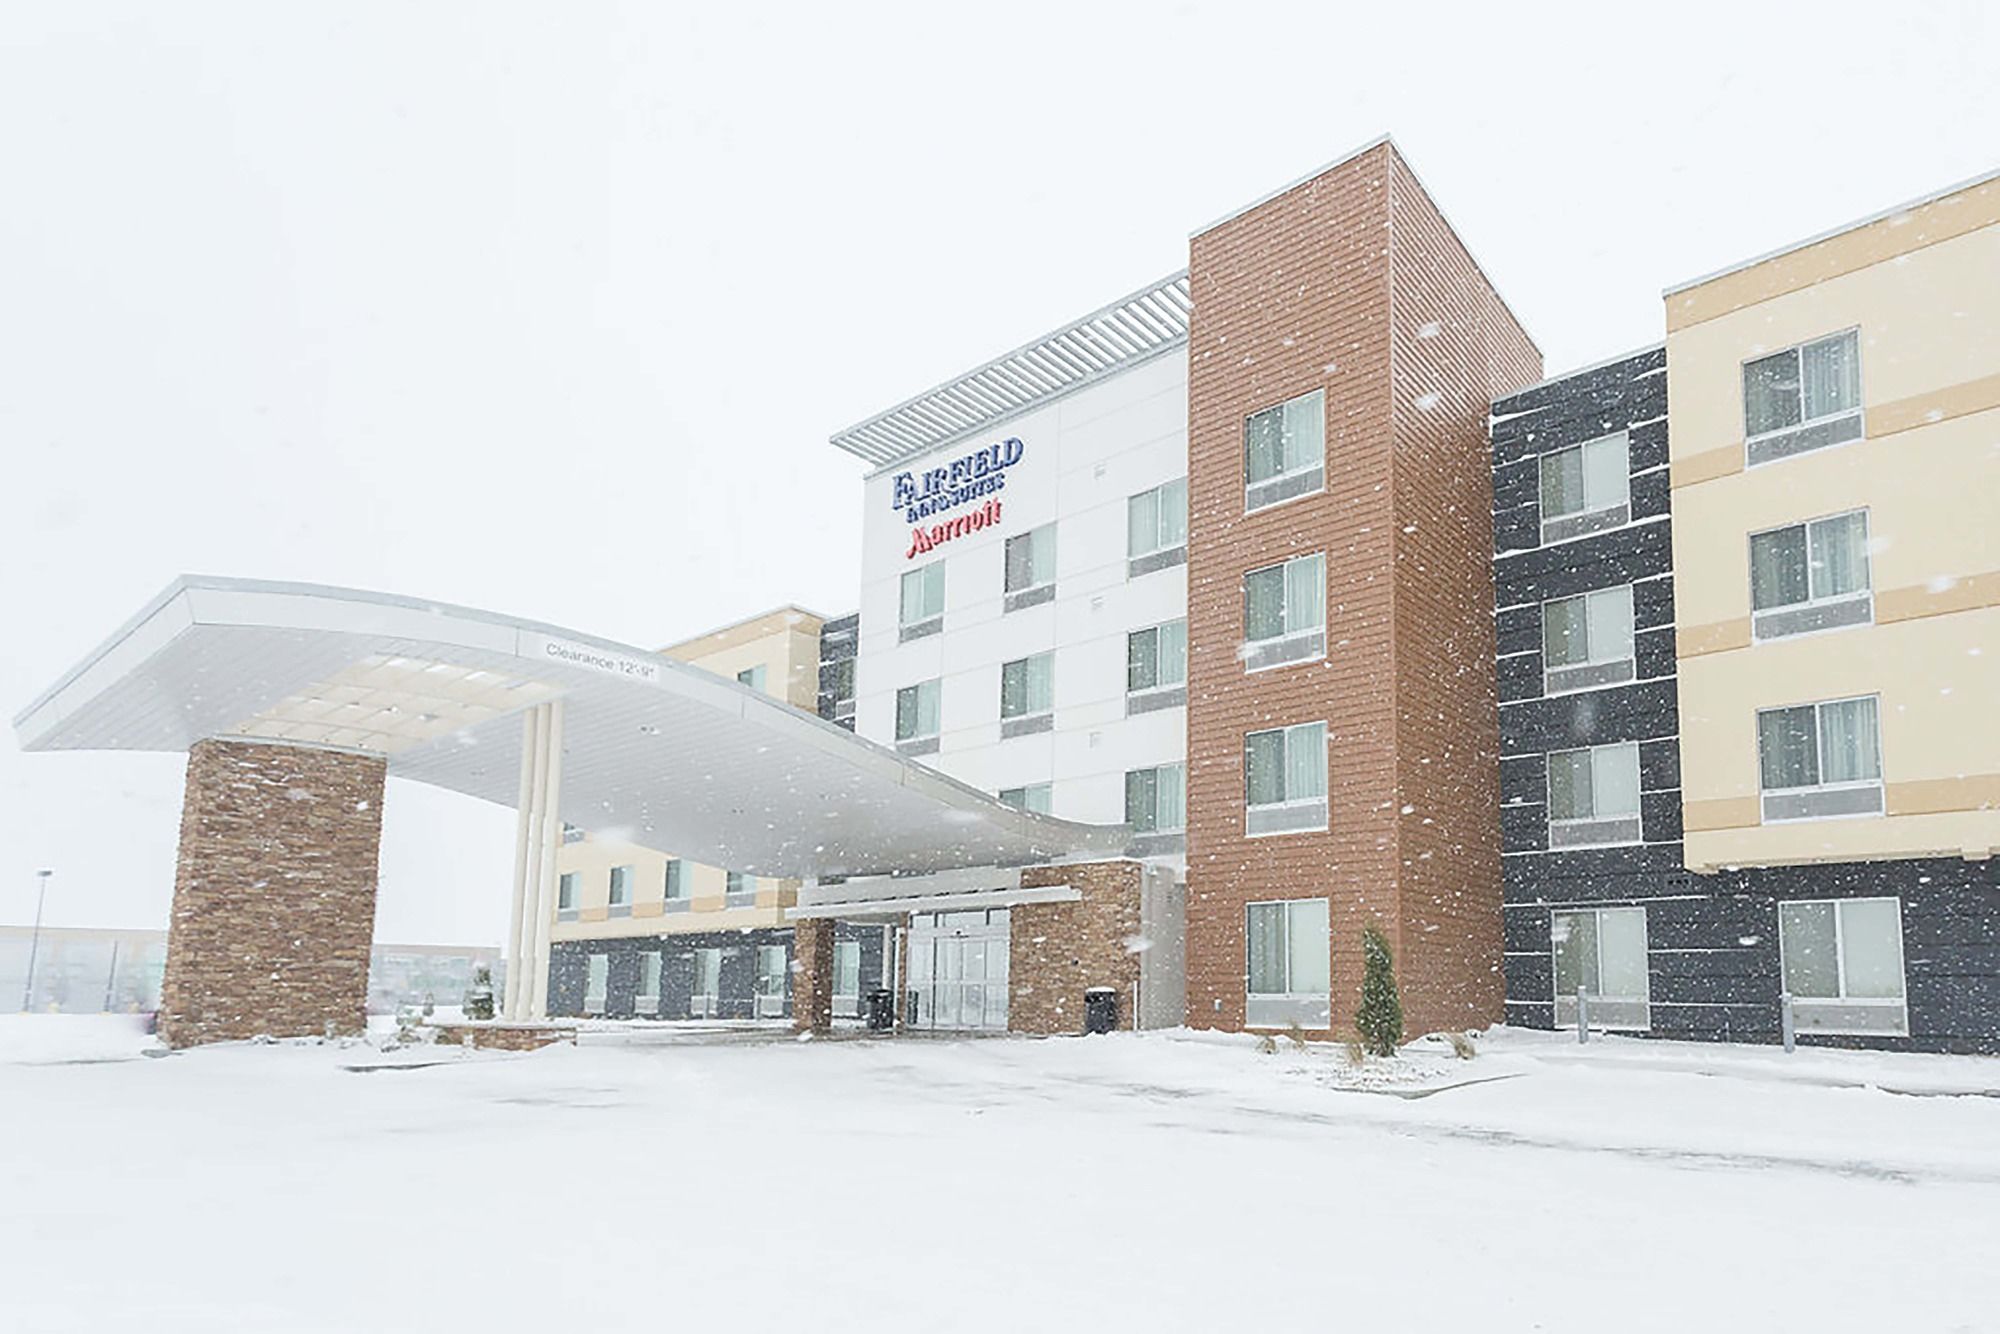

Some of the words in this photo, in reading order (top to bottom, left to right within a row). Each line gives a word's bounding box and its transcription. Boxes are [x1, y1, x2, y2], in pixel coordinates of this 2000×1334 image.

[892, 436, 1024, 511] FAIRFIELD
[906, 497, 1002, 560] Marriott
[546, 642, 615, 670] Clearance
